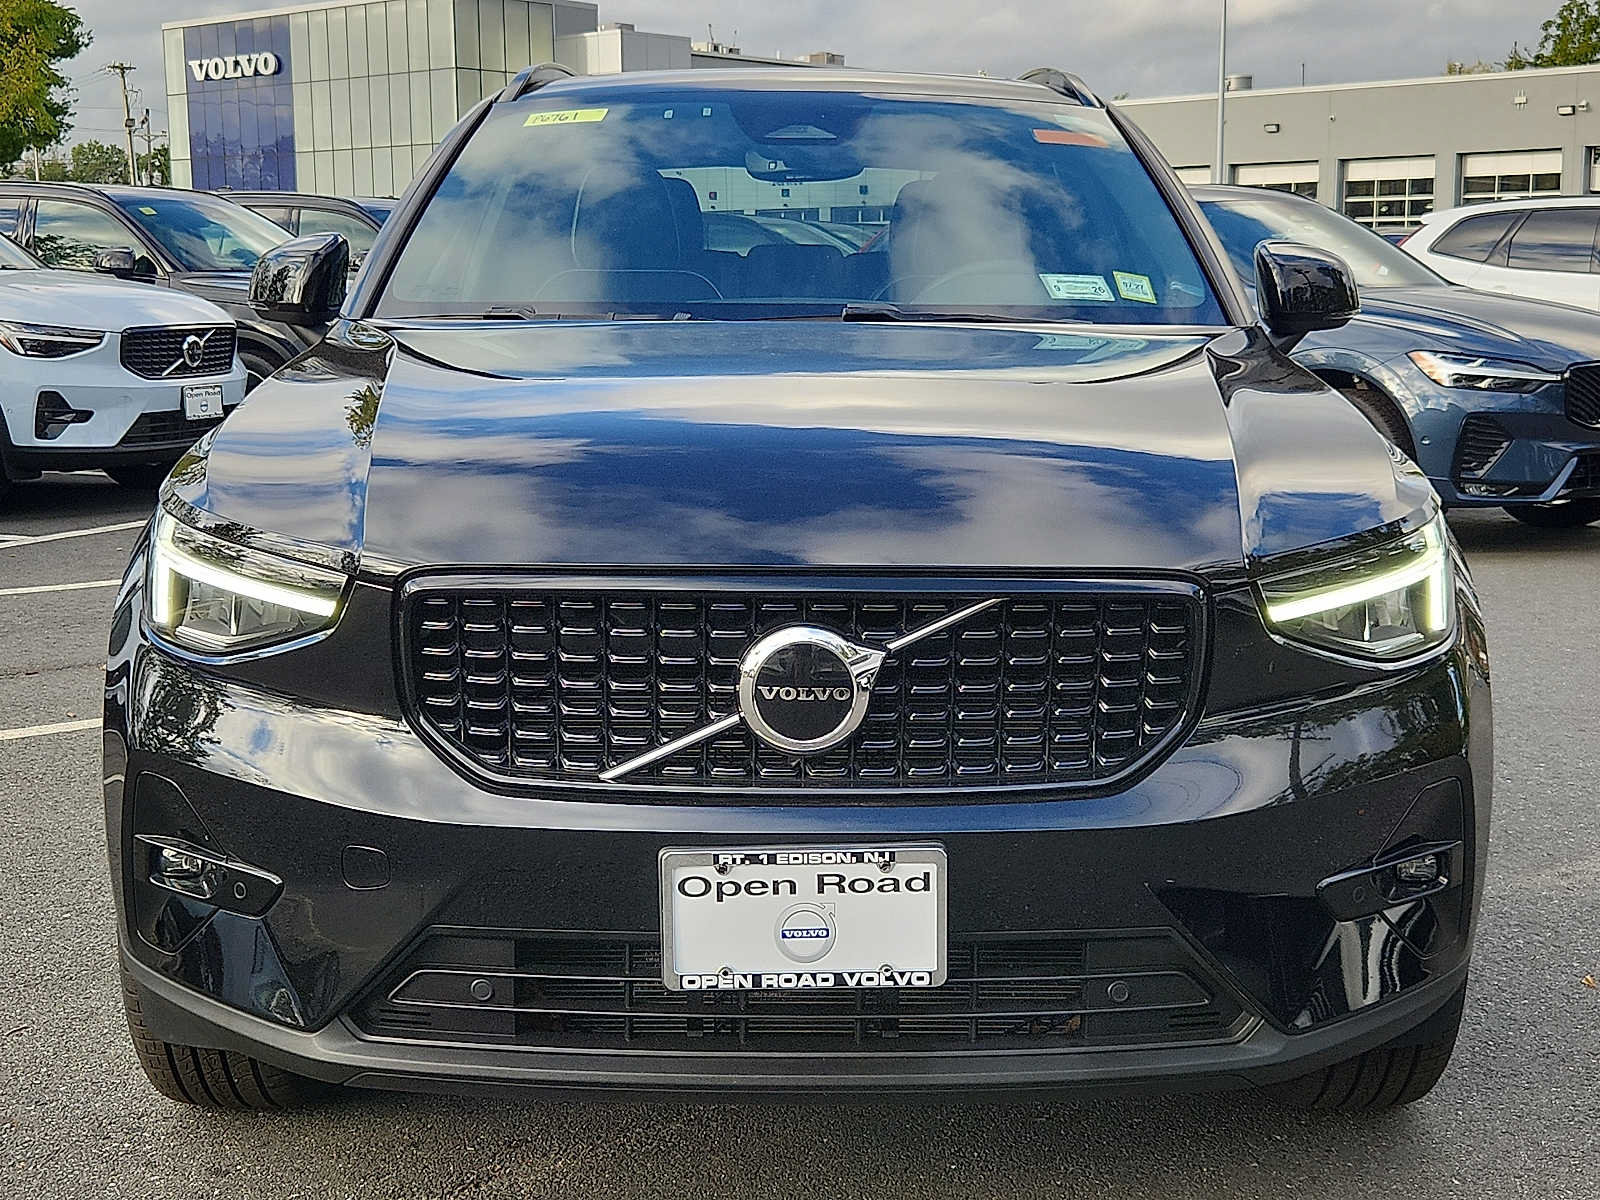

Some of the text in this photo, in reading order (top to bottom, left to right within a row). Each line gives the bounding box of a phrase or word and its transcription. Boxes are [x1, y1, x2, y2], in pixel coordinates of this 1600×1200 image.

[188, 52, 279, 81] VOLVO
[757, 686, 851, 701] VOLVO
[718, 852, 890, 865] RT. 1 EDISON, NJ
[678, 872, 931, 902] Open Road
[783, 929, 827, 938] VOLVO
[681, 971, 931, 989] OPEN ROAD VOLVO
